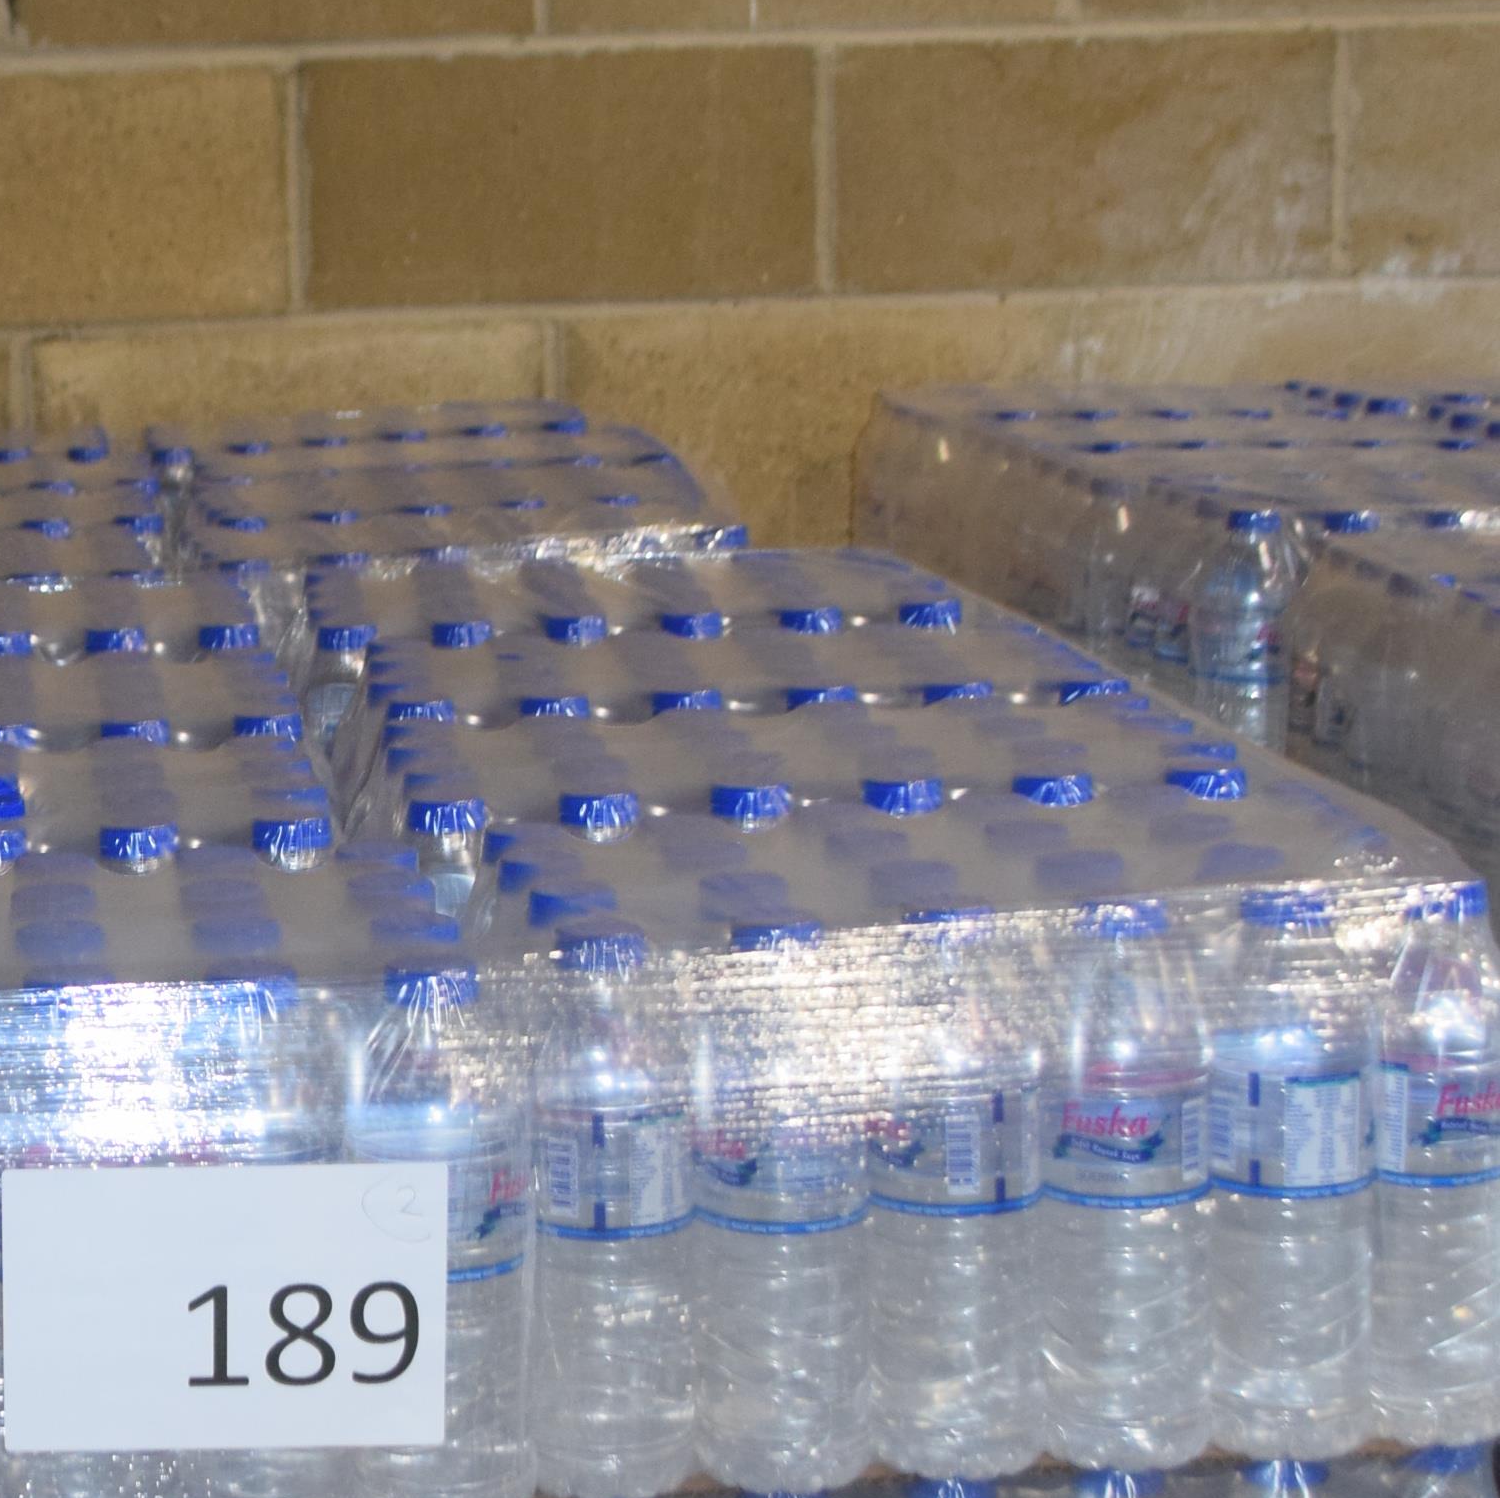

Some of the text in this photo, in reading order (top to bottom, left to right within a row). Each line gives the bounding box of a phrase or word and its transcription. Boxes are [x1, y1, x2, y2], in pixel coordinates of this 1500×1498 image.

[1436, 1081, 1500, 1117] Fusk
[1063, 1100, 1148, 1136] Fuska
[187, 1280, 420, 1387] 189
